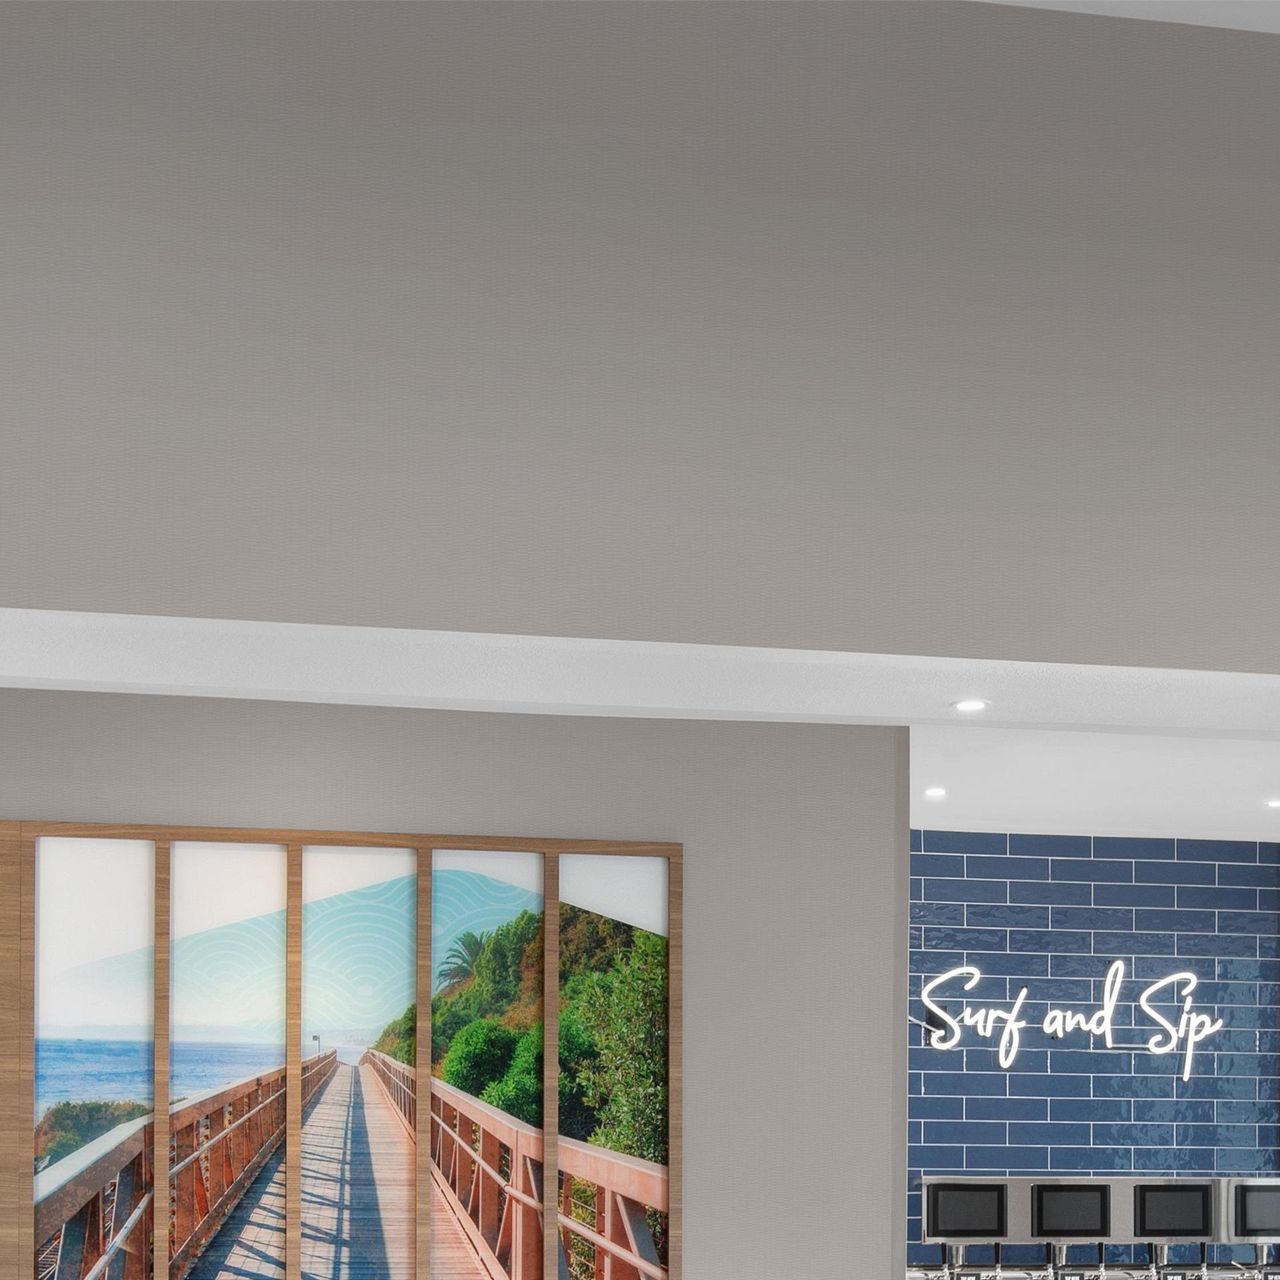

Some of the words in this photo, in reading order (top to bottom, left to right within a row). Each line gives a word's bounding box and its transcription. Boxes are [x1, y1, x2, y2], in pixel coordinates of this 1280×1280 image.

[920, 966, 1027, 1069] Surf
[1042, 960, 1125, 1049] and
[1139, 972, 1223, 1082] Sip
